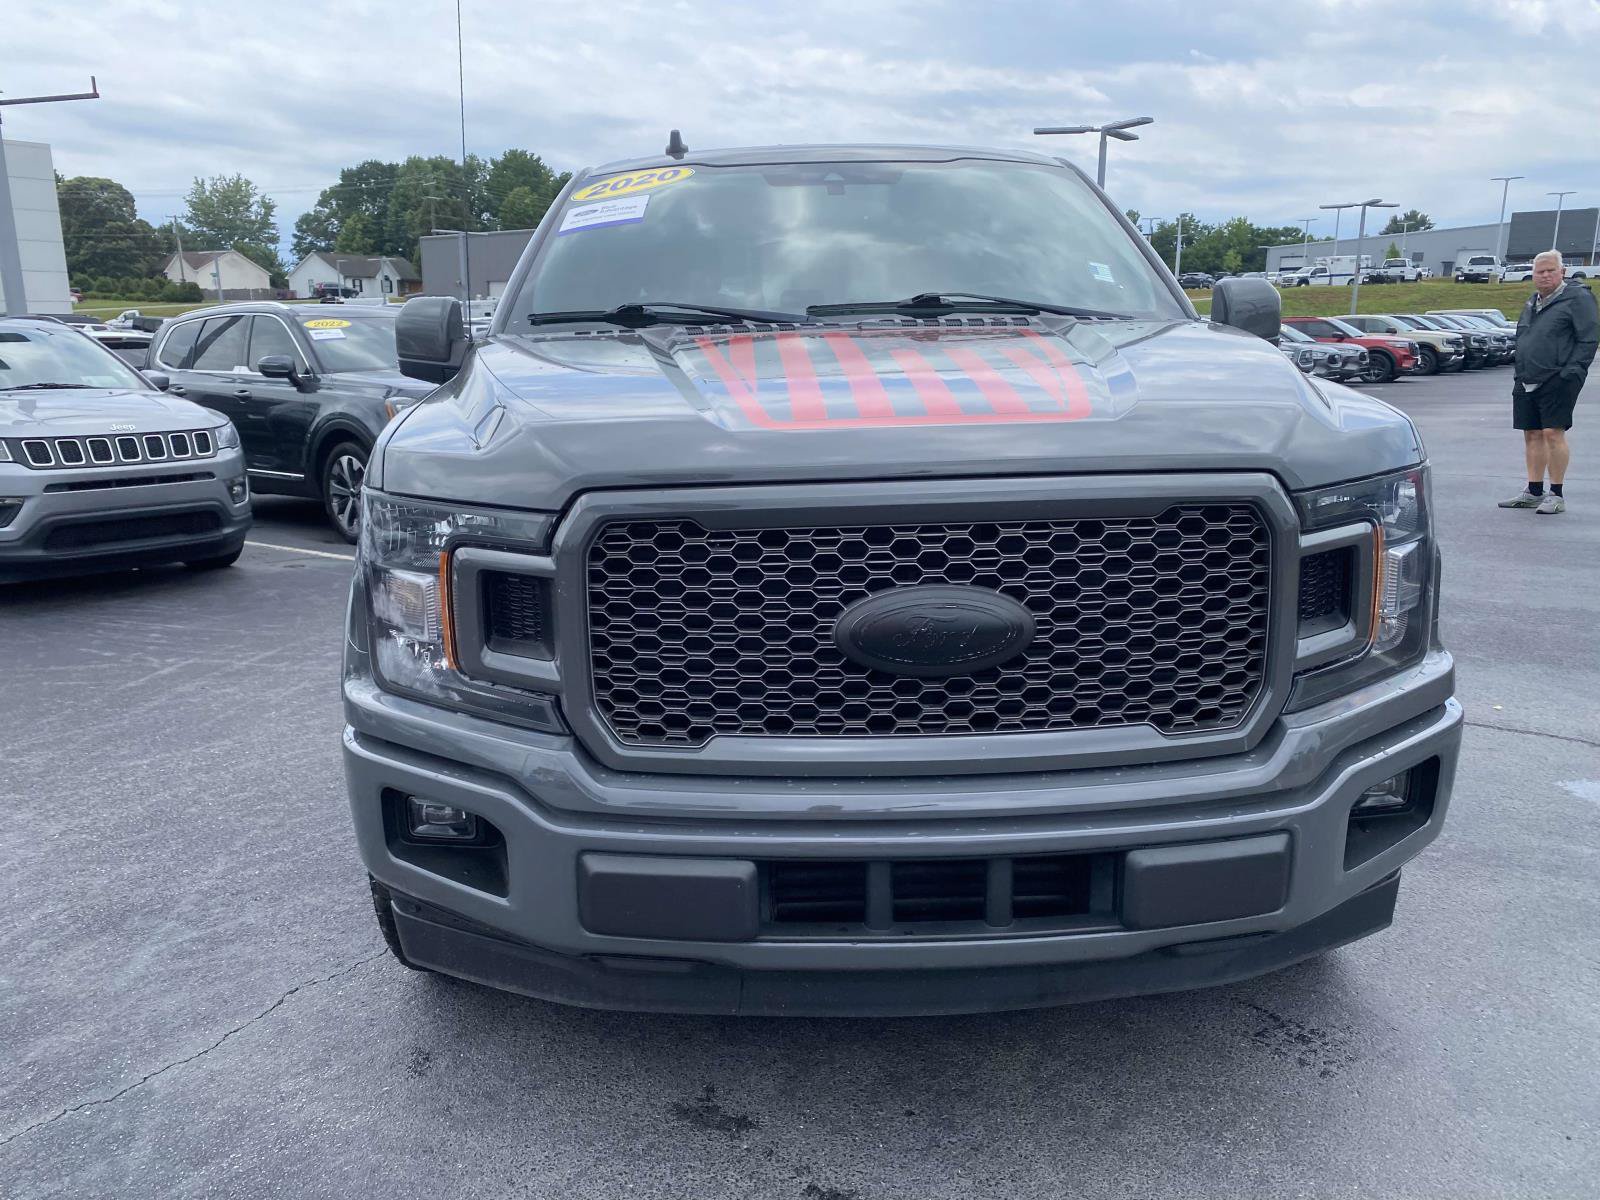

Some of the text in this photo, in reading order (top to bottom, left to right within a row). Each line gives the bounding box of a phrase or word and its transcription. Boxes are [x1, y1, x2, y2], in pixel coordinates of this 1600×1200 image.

[584, 169, 681, 198] 2020
[110, 423, 136, 431] Jeep
[893, 615, 980, 649] Ford
